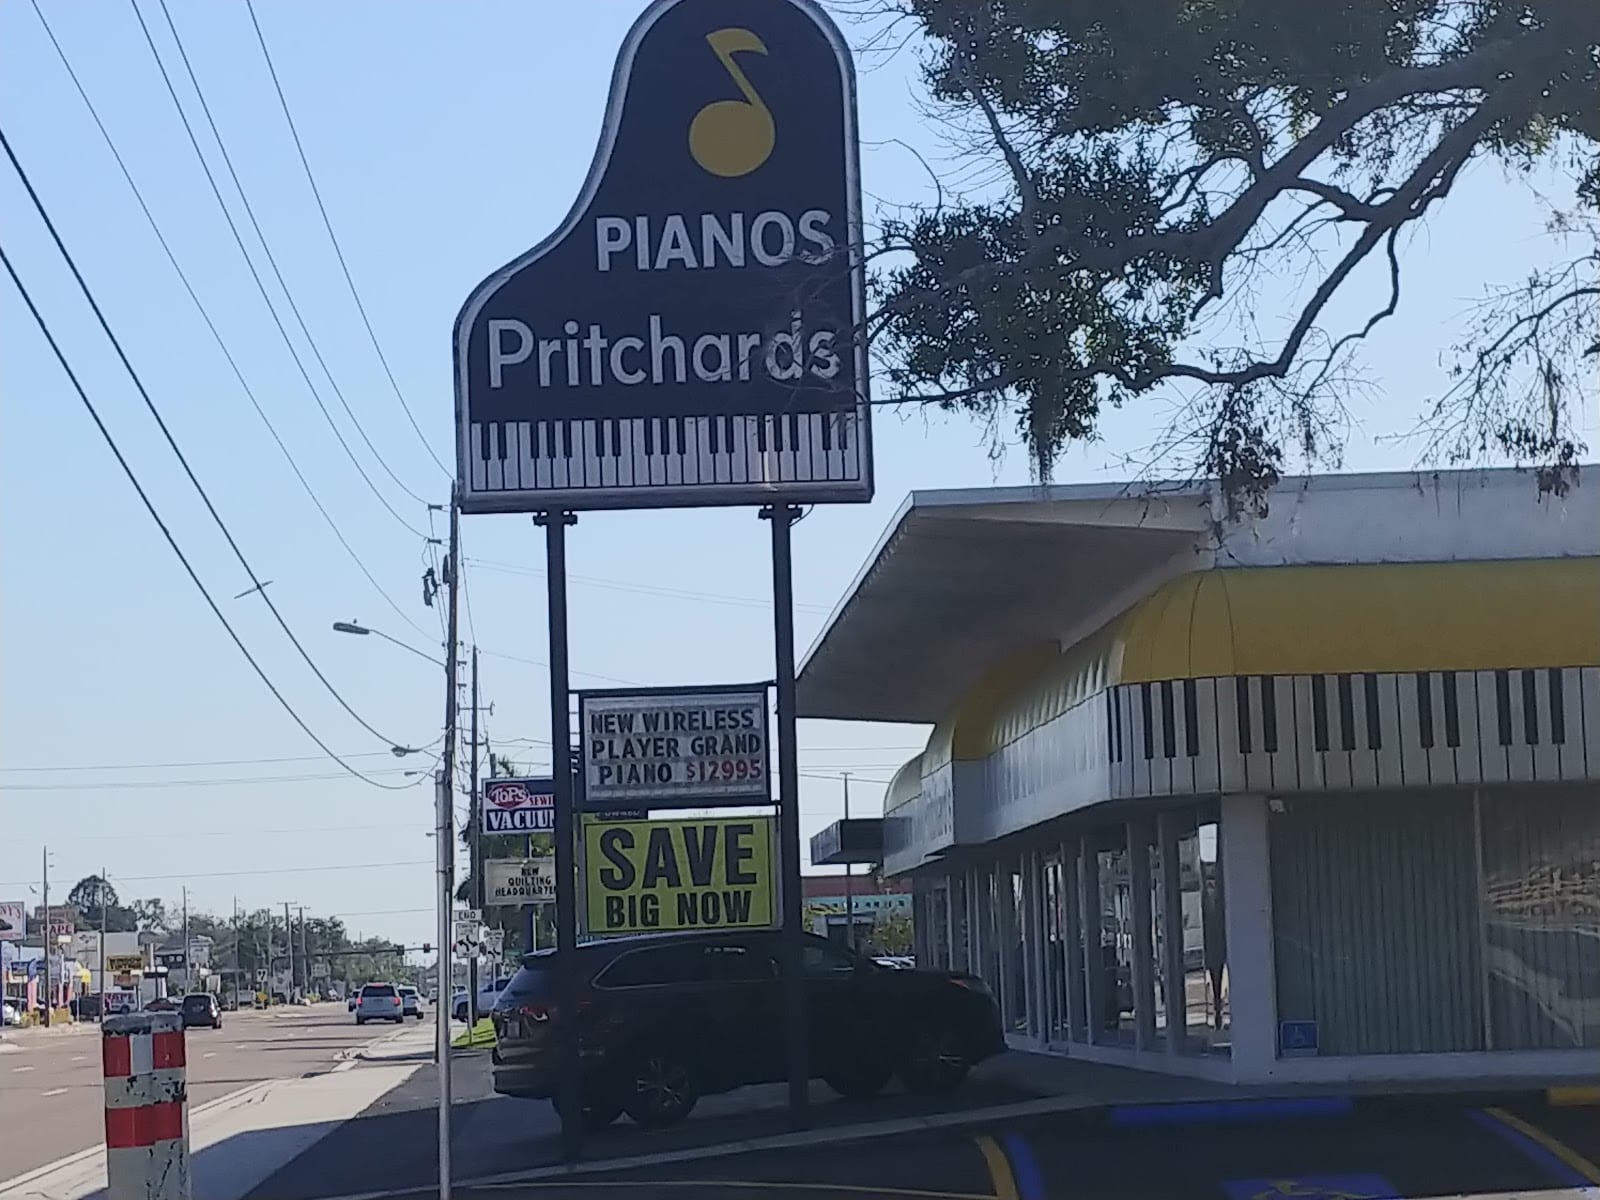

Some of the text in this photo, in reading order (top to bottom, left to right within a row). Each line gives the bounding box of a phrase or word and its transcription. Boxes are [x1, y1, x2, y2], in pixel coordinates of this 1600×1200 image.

[595, 210, 835, 271] PIANOS
[488, 309, 840, 389] Pritchards
[590, 709, 754, 735] NEW WIRELESS
[591, 733, 761, 760] PLAYER GRAND
[600, 759, 761, 785] PIANO $12995
[529, 795, 553, 806] SEWI
[600, 824, 757, 891] SAVE
[508, 876, 552, 887] QUILTING
[606, 890, 752, 928] BIG NOW
